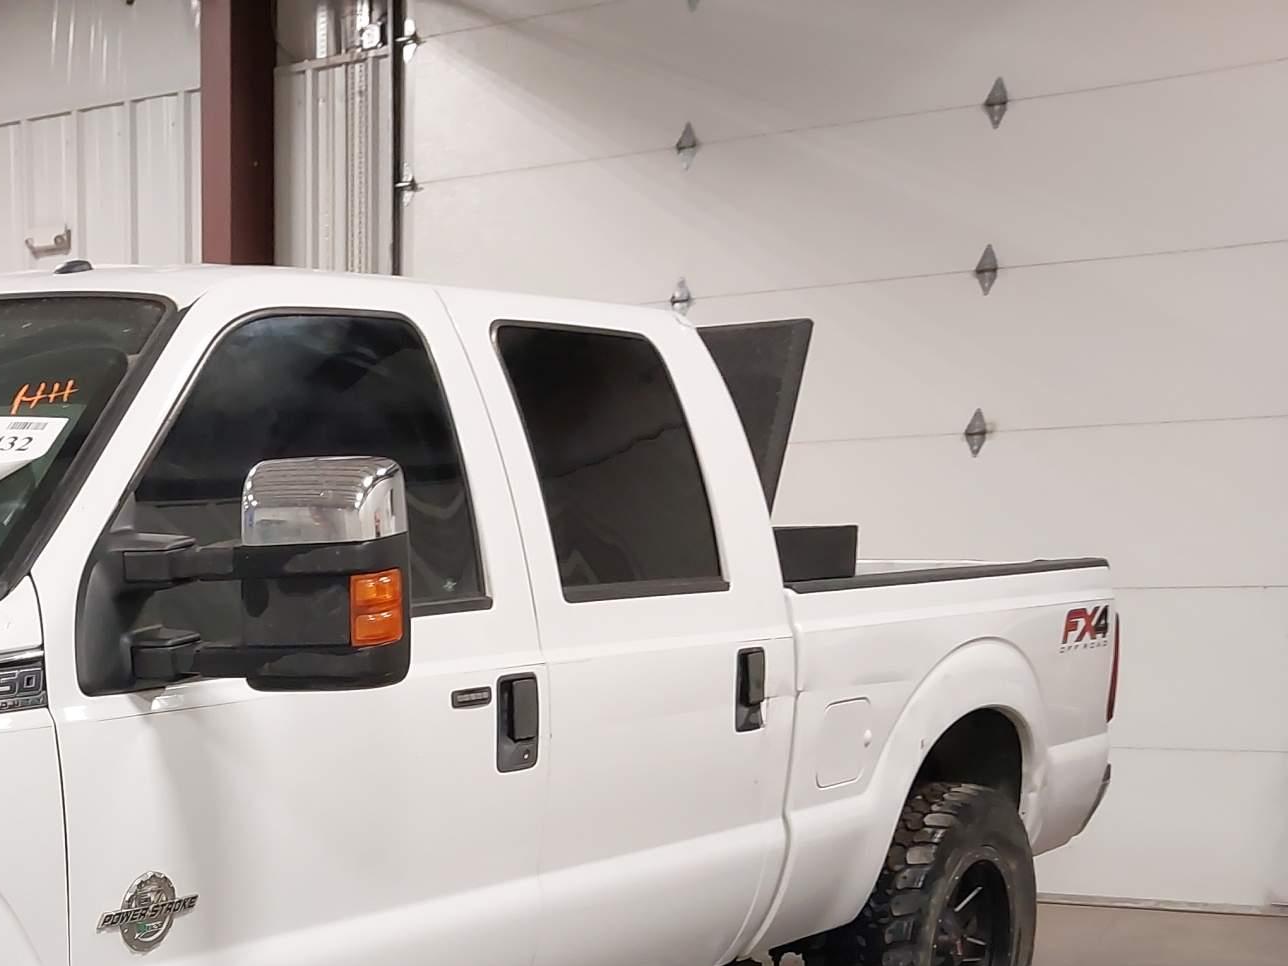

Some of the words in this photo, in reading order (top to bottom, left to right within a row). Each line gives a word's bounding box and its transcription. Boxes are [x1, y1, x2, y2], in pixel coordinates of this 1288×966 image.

[1061, 604, 1109, 644] FX4
[100, 906, 148, 926] POWER
[149, 894, 198, 918] STROKE
